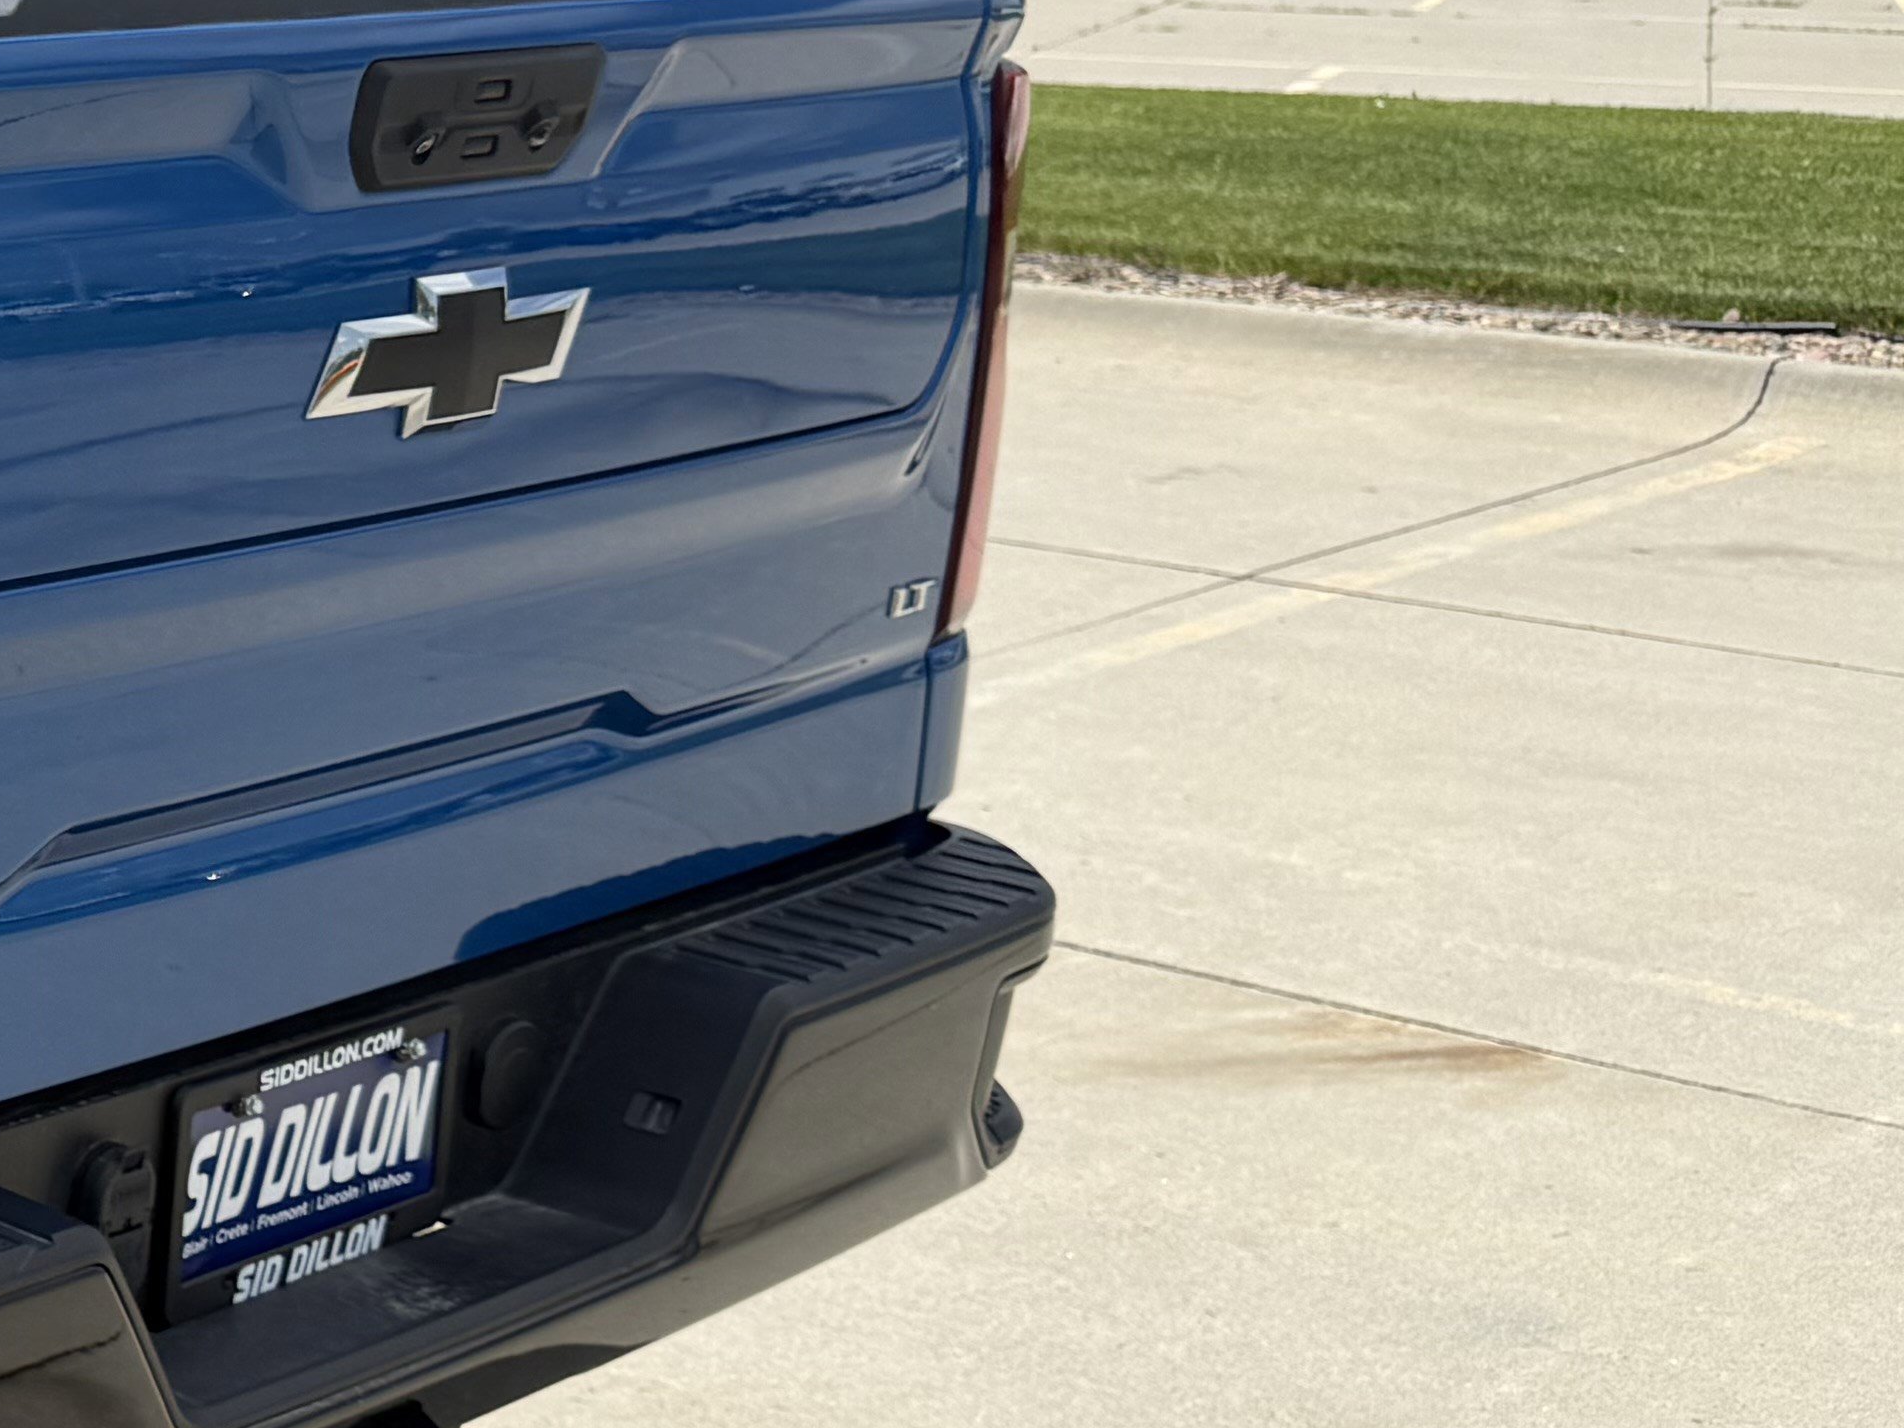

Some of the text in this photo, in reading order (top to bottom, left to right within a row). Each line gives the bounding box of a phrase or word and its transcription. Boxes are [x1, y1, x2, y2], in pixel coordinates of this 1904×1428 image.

[889, 577, 938, 619] LT
[259, 1026, 404, 1092] SIDDILLON.COM
[182, 1059, 439, 1237] SID DILLON
[232, 1215, 389, 1305] SID DILLON
